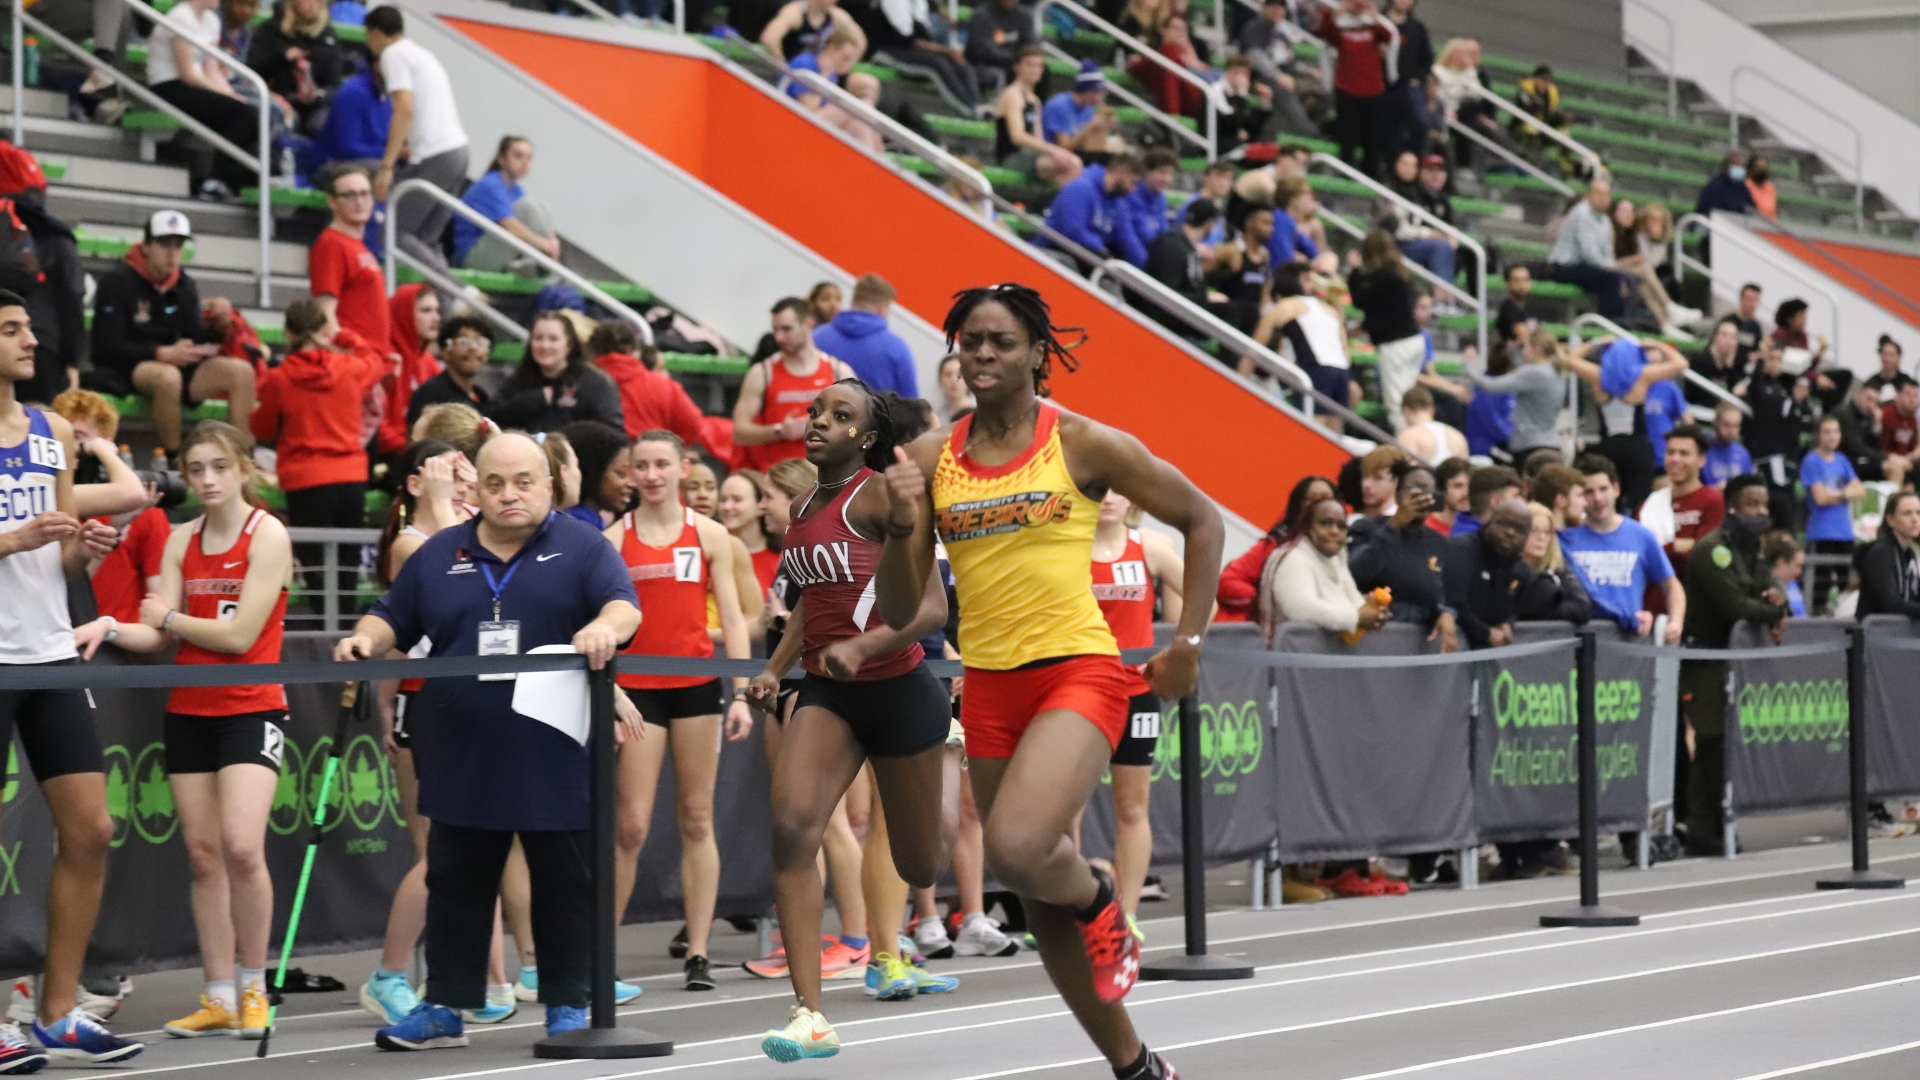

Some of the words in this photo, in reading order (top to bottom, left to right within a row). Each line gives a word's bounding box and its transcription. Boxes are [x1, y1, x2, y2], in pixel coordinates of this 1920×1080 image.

[33, 438, 59, 467] 15
[951, 495, 1014, 513] UNIVERSITY
[1016, 494, 1028, 502] OF
[1030, 491, 1048, 500] THE
[678, 551, 695, 578] 7
[782, 541, 855, 587] OLLOY
[1116, 563, 1138, 584] 11
[1493, 669, 1567, 728] Ocean
[1569, 668, 1641, 725] eeze
[1136, 715, 1154, 736] 11
[1490, 736, 1566, 786] Athletic
[1567, 733, 1638, 791] Cplex
